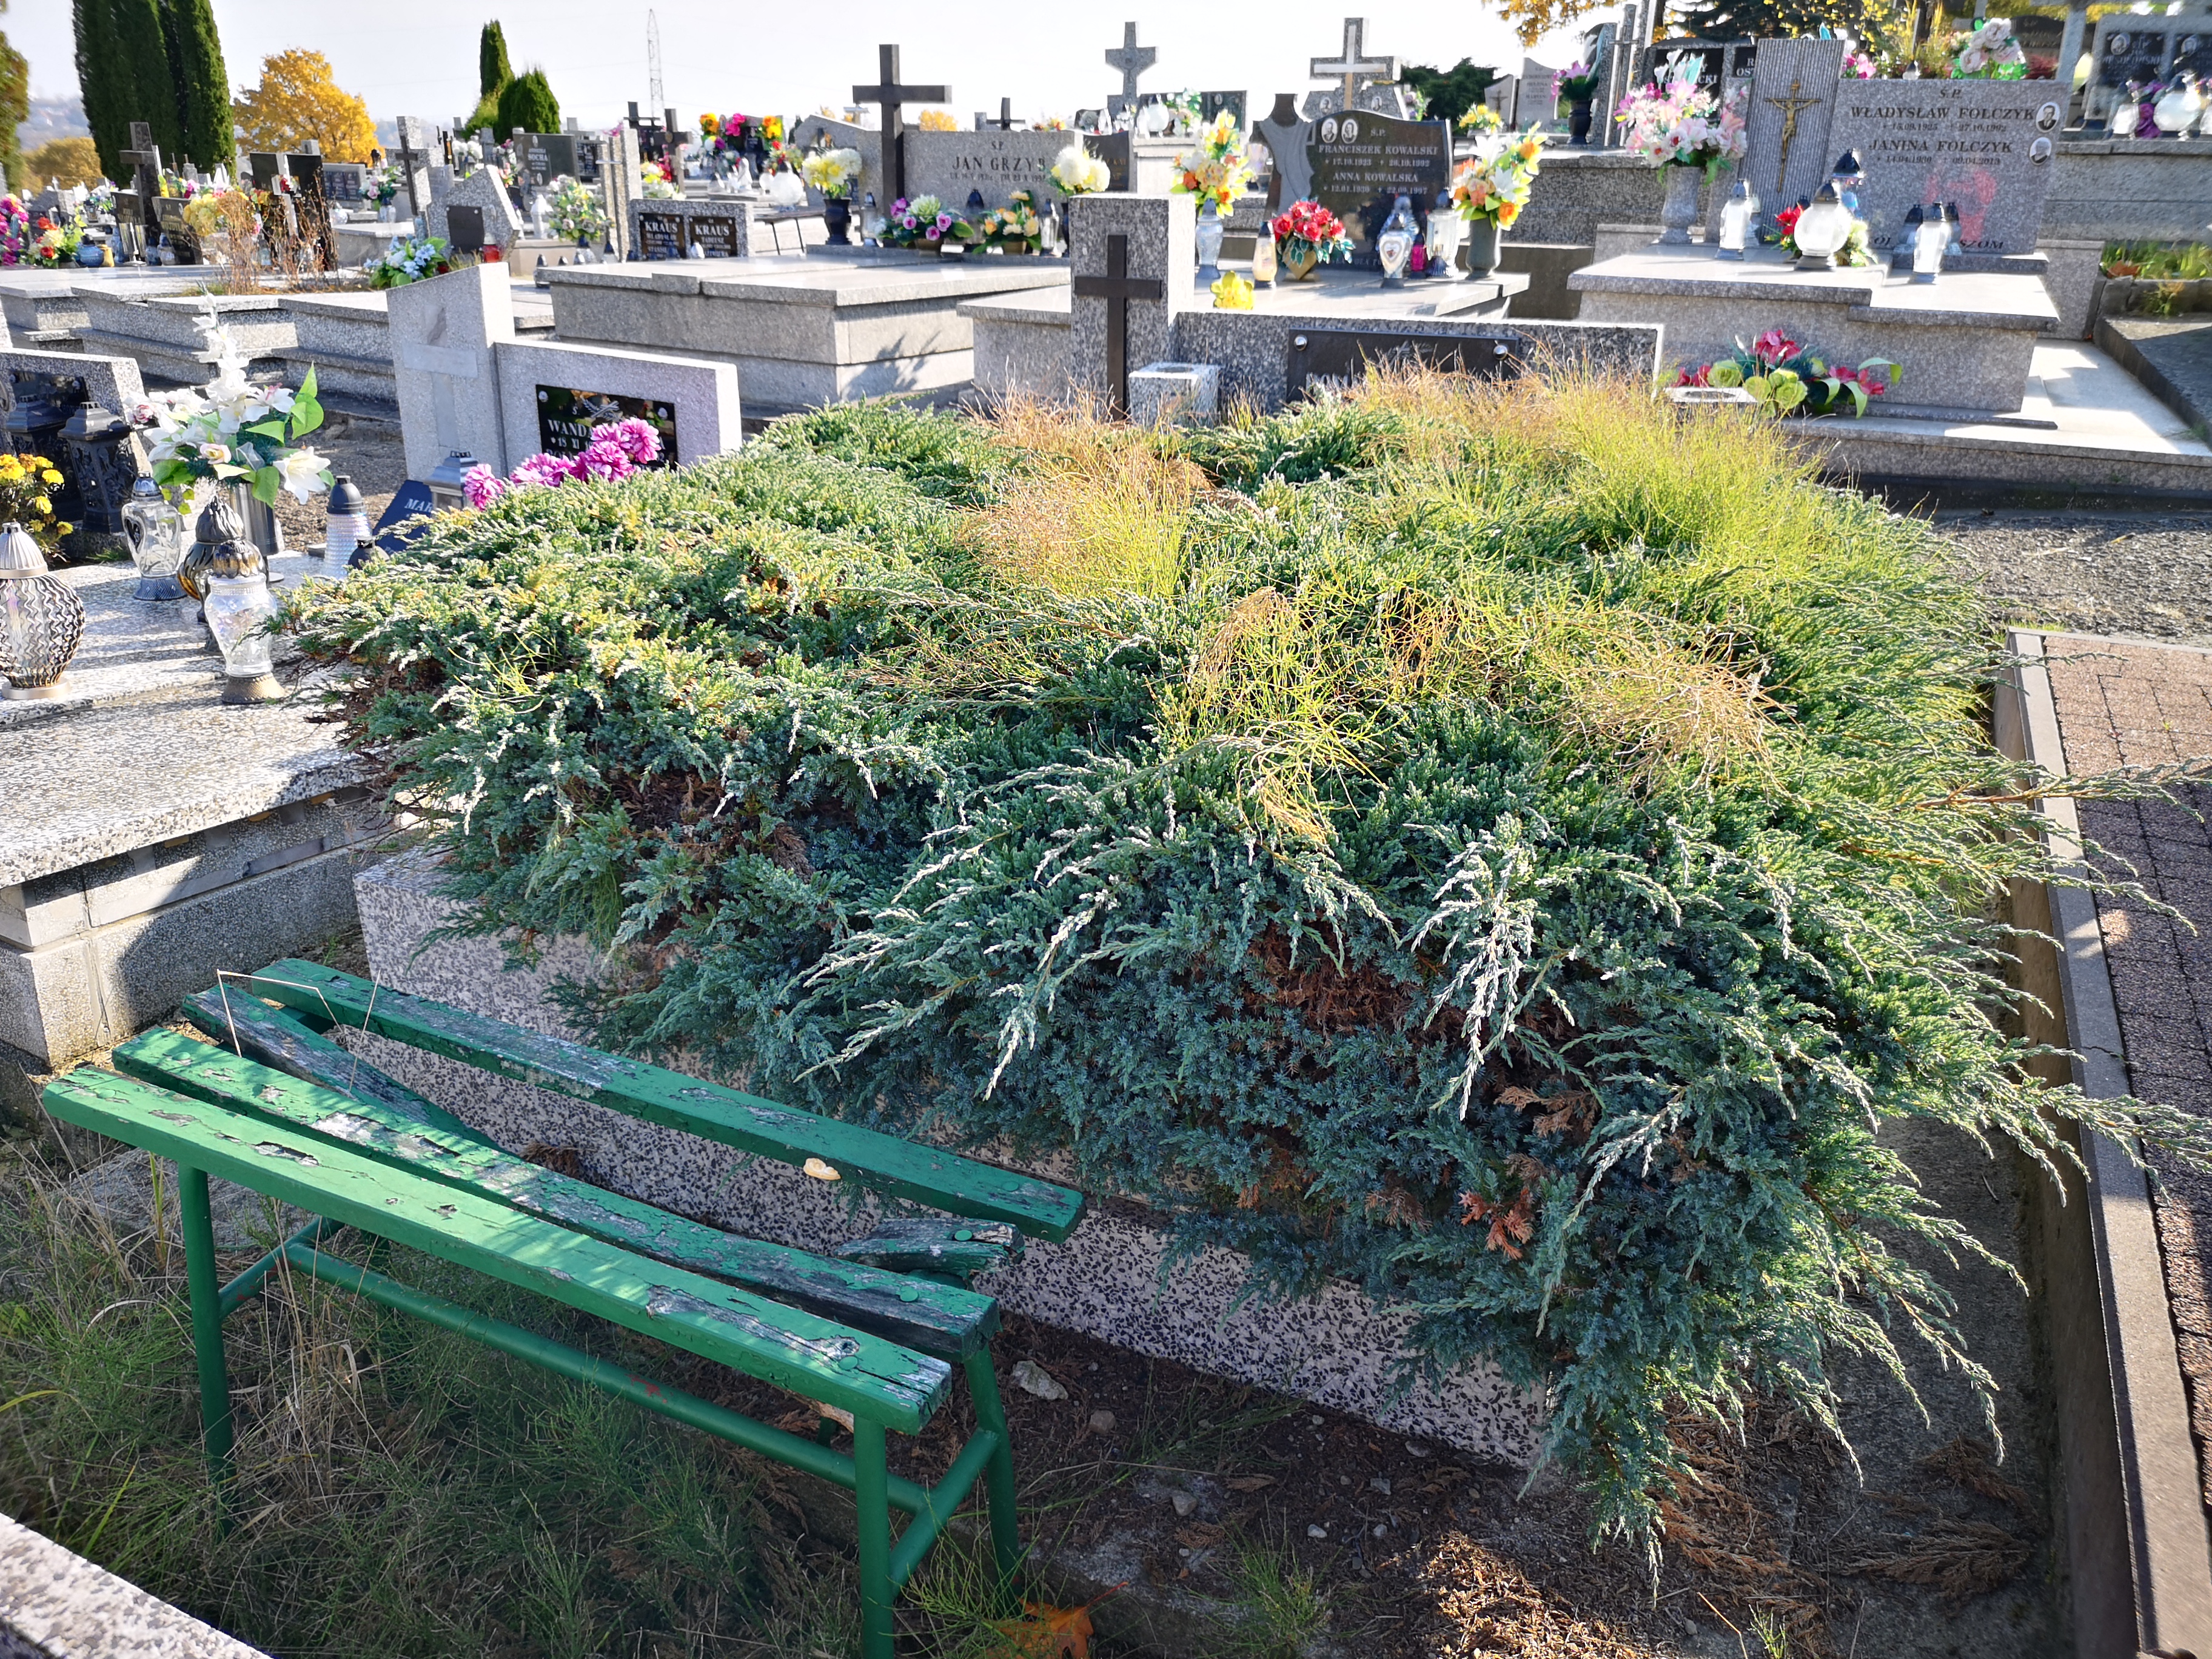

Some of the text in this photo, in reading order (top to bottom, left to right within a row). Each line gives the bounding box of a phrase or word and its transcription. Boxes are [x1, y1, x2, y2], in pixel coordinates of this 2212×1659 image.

[1851, 106, 2035, 119] WŁADYSŁAW FOLCZYK
[1318, 144, 1439, 155] FRANCISZEK KOWALSKI
[1869, 139, 2013, 153] JANINA FOLCZYK
[952, 156, 1046, 172] JAN GRZYB
[1333, 172, 1419, 183] ANNA KOWALSKA
[645, 222, 678, 233] KRAUS
[695, 225, 730, 236] KRAUS
